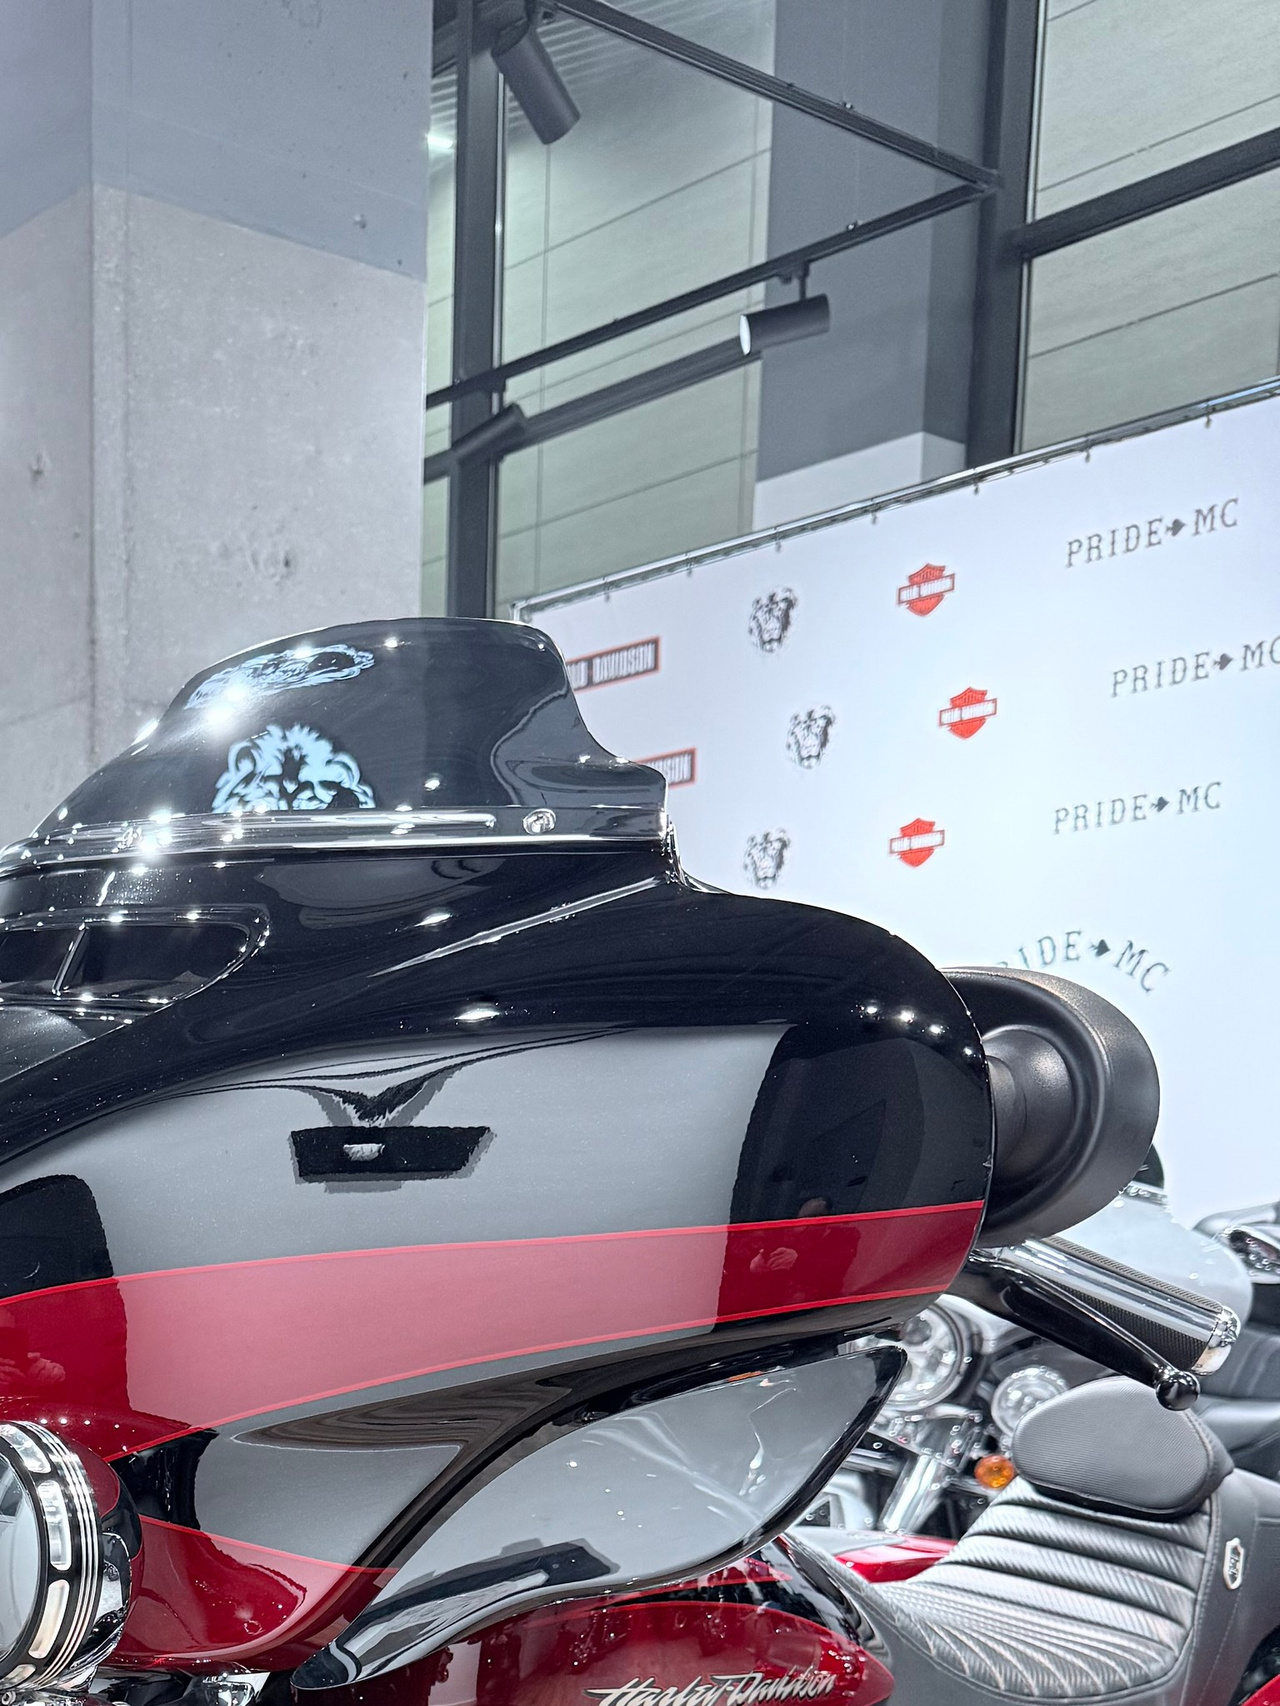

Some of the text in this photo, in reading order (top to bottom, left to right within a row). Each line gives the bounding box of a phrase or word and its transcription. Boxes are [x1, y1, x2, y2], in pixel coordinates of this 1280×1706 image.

[1065, 498, 1238, 568] PRIDE MC
[1111, 650, 1211, 698] PRIDE
[1054, 781, 1222, 835] PRIDE MC
[996, 929, 1171, 994] IDE MC
